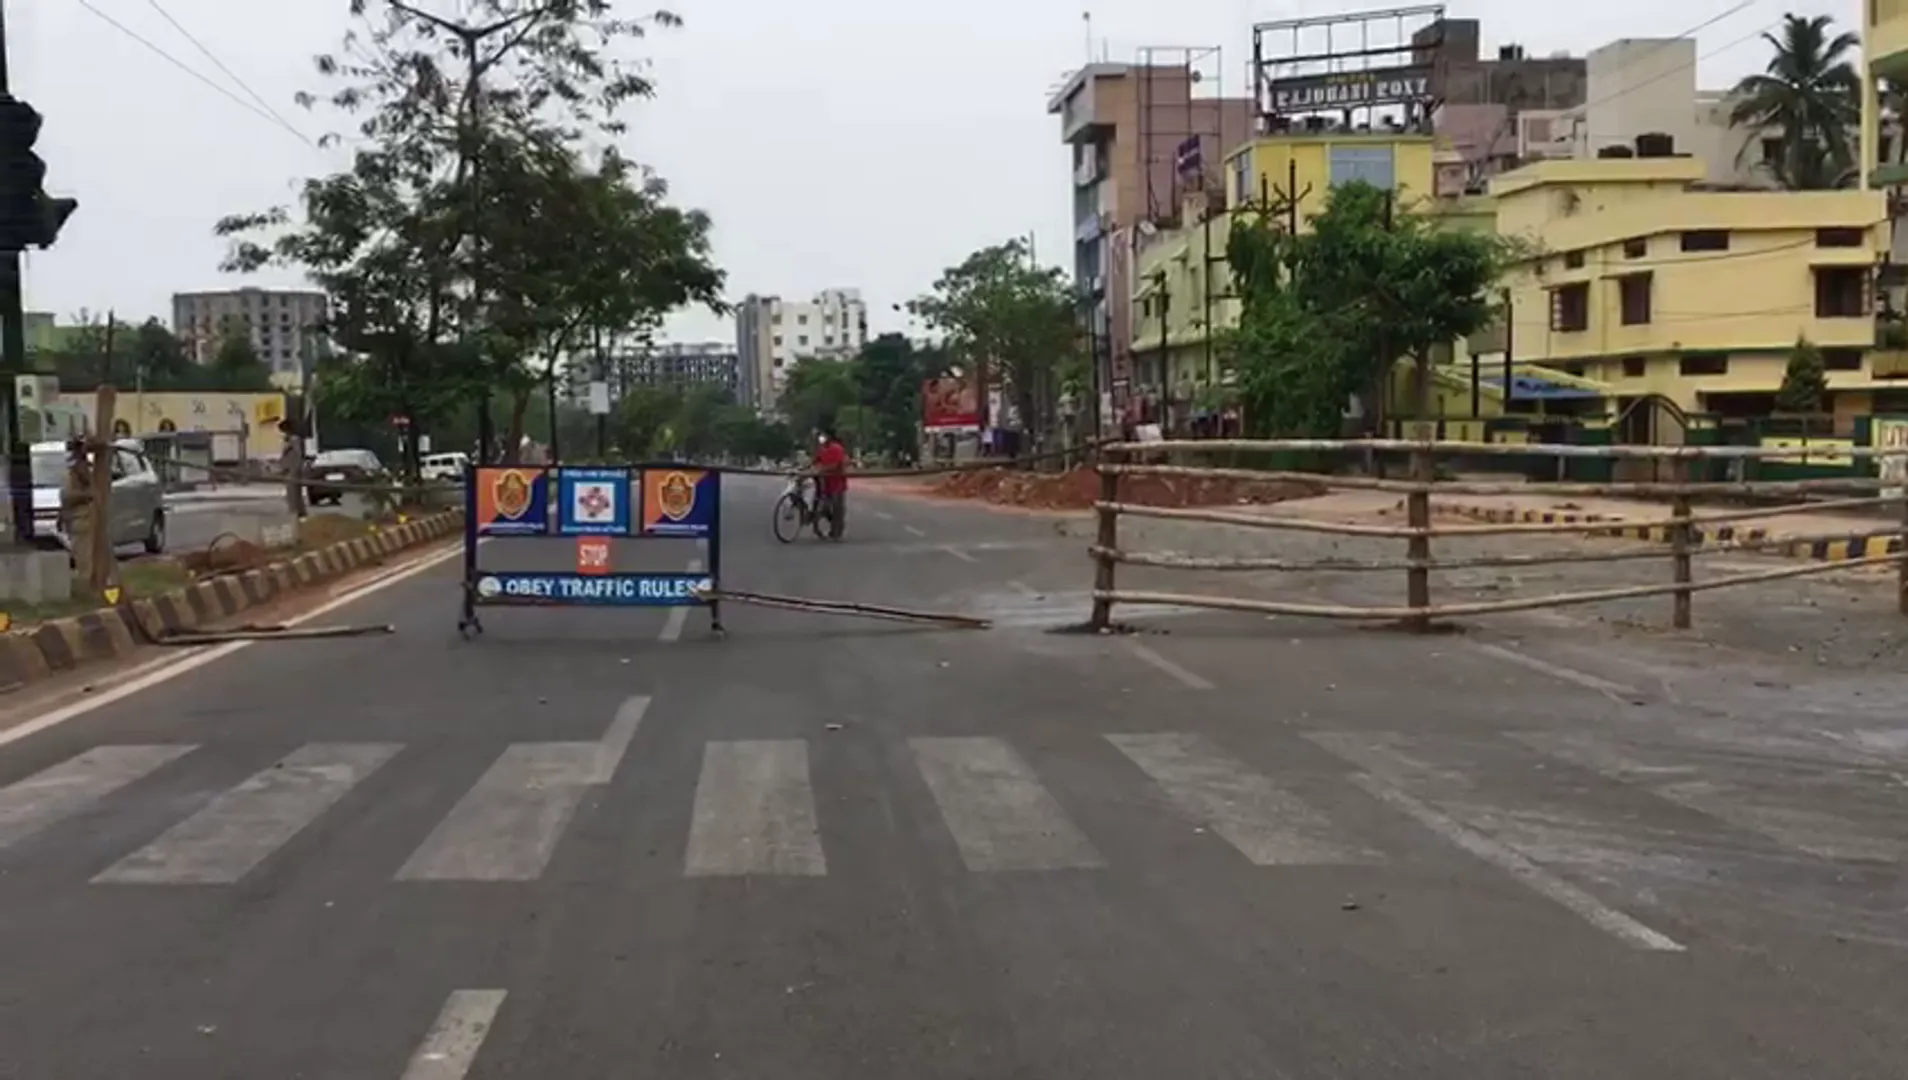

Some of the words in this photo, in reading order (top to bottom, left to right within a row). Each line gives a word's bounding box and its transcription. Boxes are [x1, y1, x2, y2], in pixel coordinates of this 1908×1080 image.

[1376, 78, 1427, 98] ROXY
[579, 544, 609, 567] STOP
[506, 578, 554, 597] OBEY
[558, 578, 634, 597] TRAFFIC
[639, 578, 699, 598] RULES
